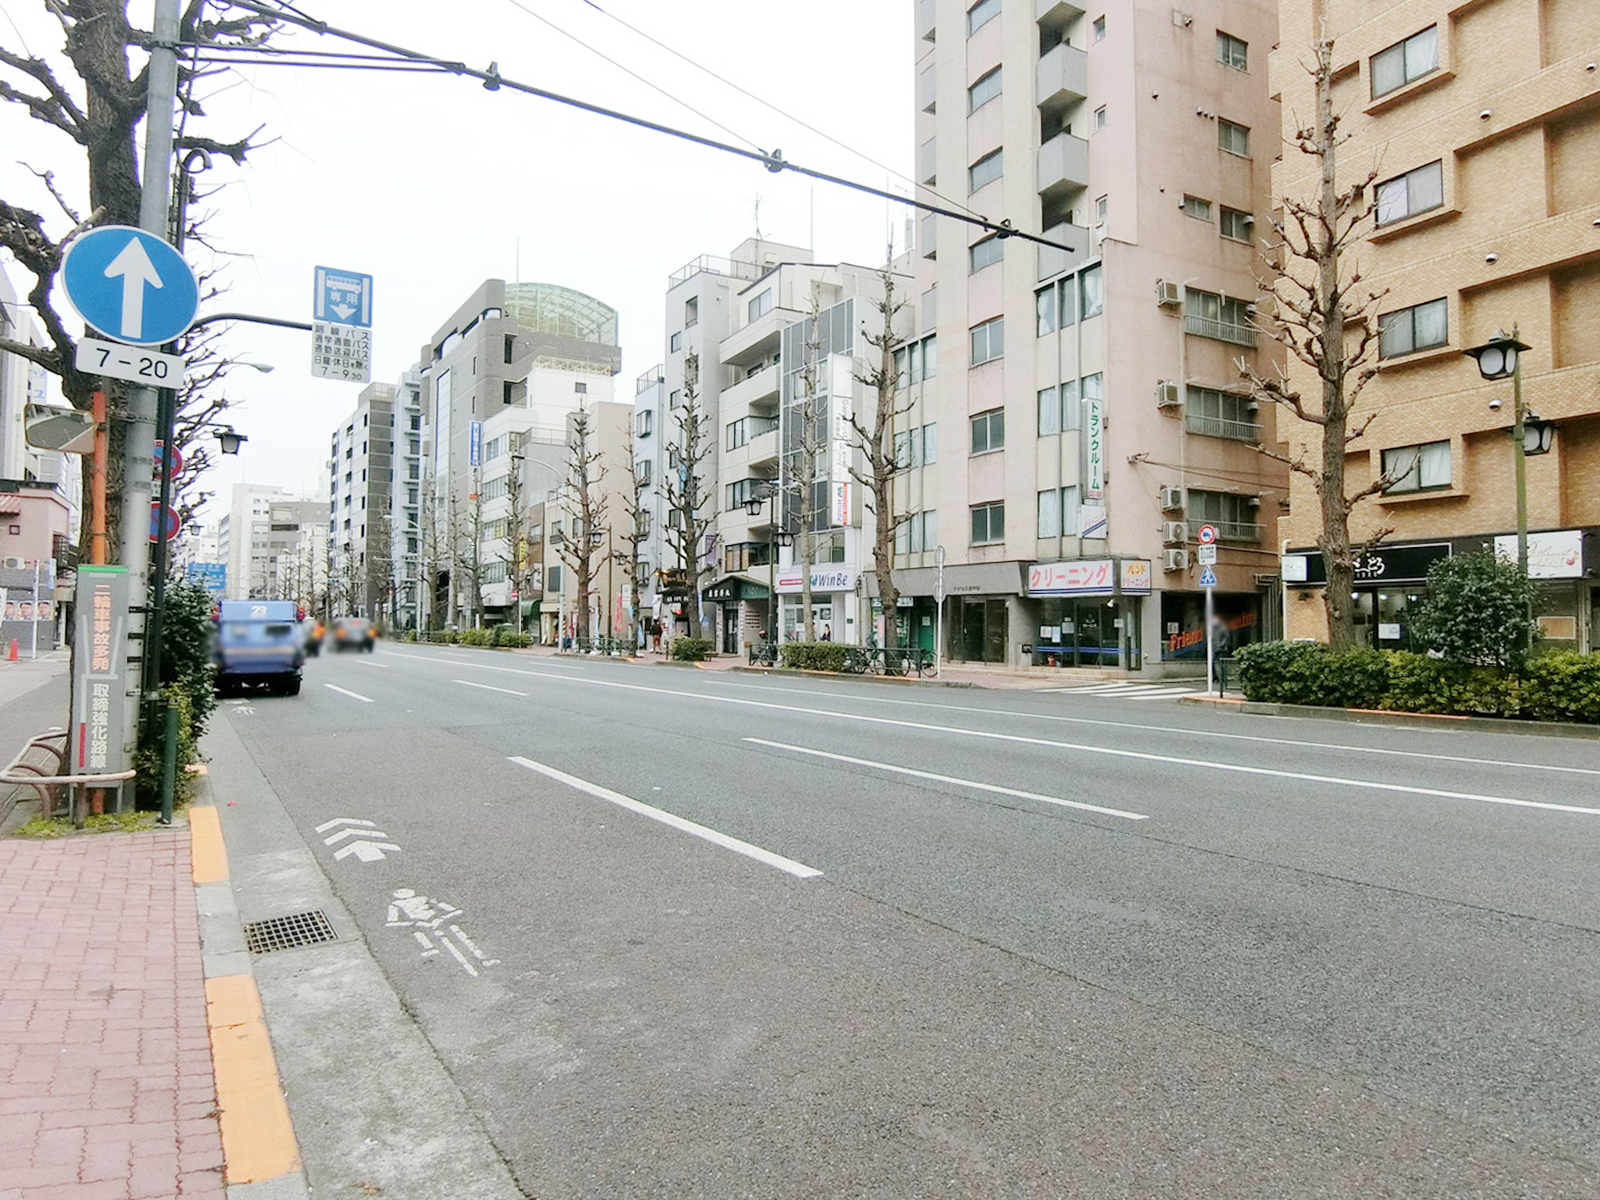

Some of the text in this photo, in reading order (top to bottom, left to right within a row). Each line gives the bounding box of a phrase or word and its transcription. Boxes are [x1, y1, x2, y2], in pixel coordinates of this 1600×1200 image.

[329, 291, 358, 306] 専用
[314, 324, 370, 341] 路線バス
[1091, 401, 1101, 490] トランクルーム
[819, 573, 848, 587] WinBe
[1031, 562, 1110, 589] クリーニング
[1121, 578, 1149, 587] クリーニング
[250, 605, 268, 617] 23
[93, 584, 111, 671] 二輪車事故多発
[90, 683, 110, 769] 取締強化路線
